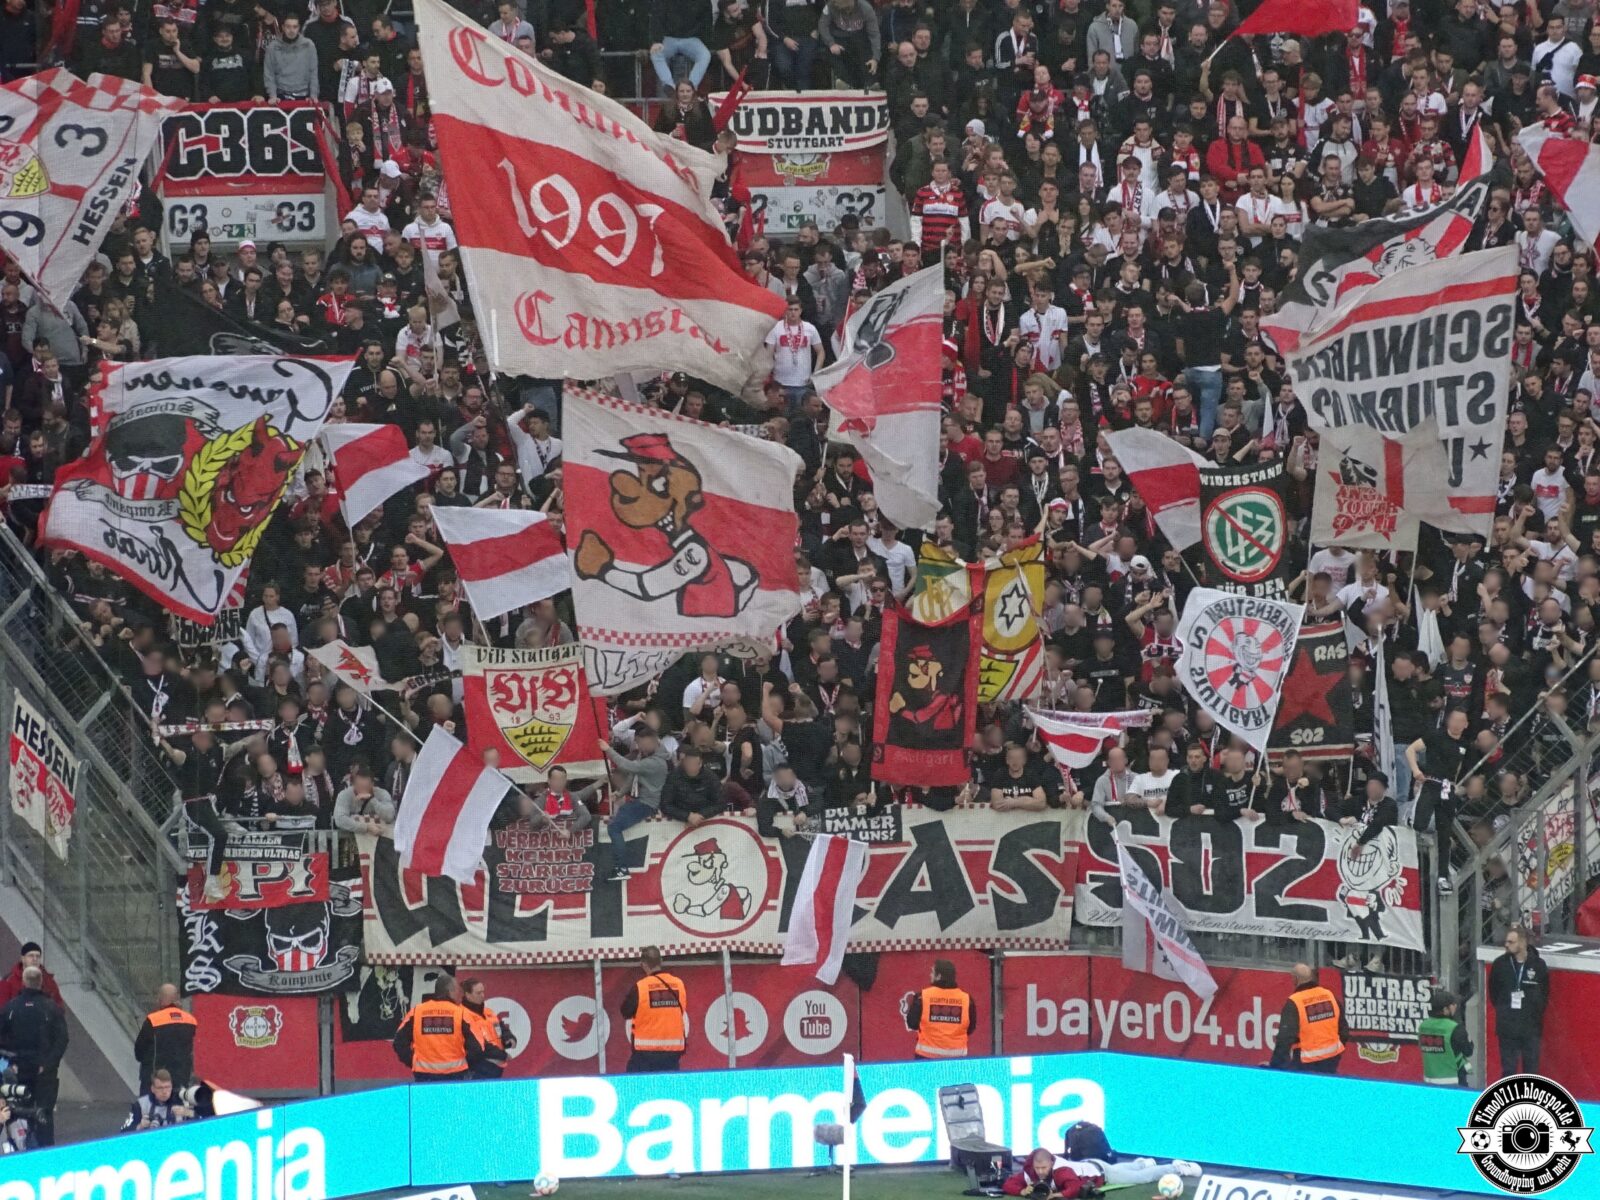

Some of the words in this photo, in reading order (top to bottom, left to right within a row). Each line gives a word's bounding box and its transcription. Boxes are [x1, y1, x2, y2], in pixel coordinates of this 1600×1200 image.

[716, 104, 890, 136] ÜDBANDE
[767, 136, 844, 149] STUTTGART
[72, 158, 137, 246] HESSEN
[751, 194, 769, 225] 2
[498, 157, 665, 277] 1997
[514, 289, 730, 354] Cannst
[1200, 463, 1284, 487] WIDERSTAND
[1253, 577, 1285, 597] DEN
[1314, 643, 1347, 662] RAS
[15, 705, 75, 797] HESSEN
[825, 806, 849, 819] DU
[856, 804, 894, 816] BT
[825, 815, 896, 833] IMMER
[243, 835, 283, 846] ALLEN
[495, 829, 594, 849] VERBANNTE
[859, 829, 897, 841] UNS!
[264, 848, 300, 860] ULTRAS
[505, 848, 586, 863] KEHRT
[268, 969, 333, 988] Kompanie
[1344, 975, 1432, 1002] ULTRAS
[804, 999, 827, 1015] You
[1026, 983, 1281, 1051] bayer04.de
[1345, 998, 1433, 1019] BEDEUTET
[802, 1020, 832, 1036] Tube
[538, 1056, 1105, 1178] Barmenia
